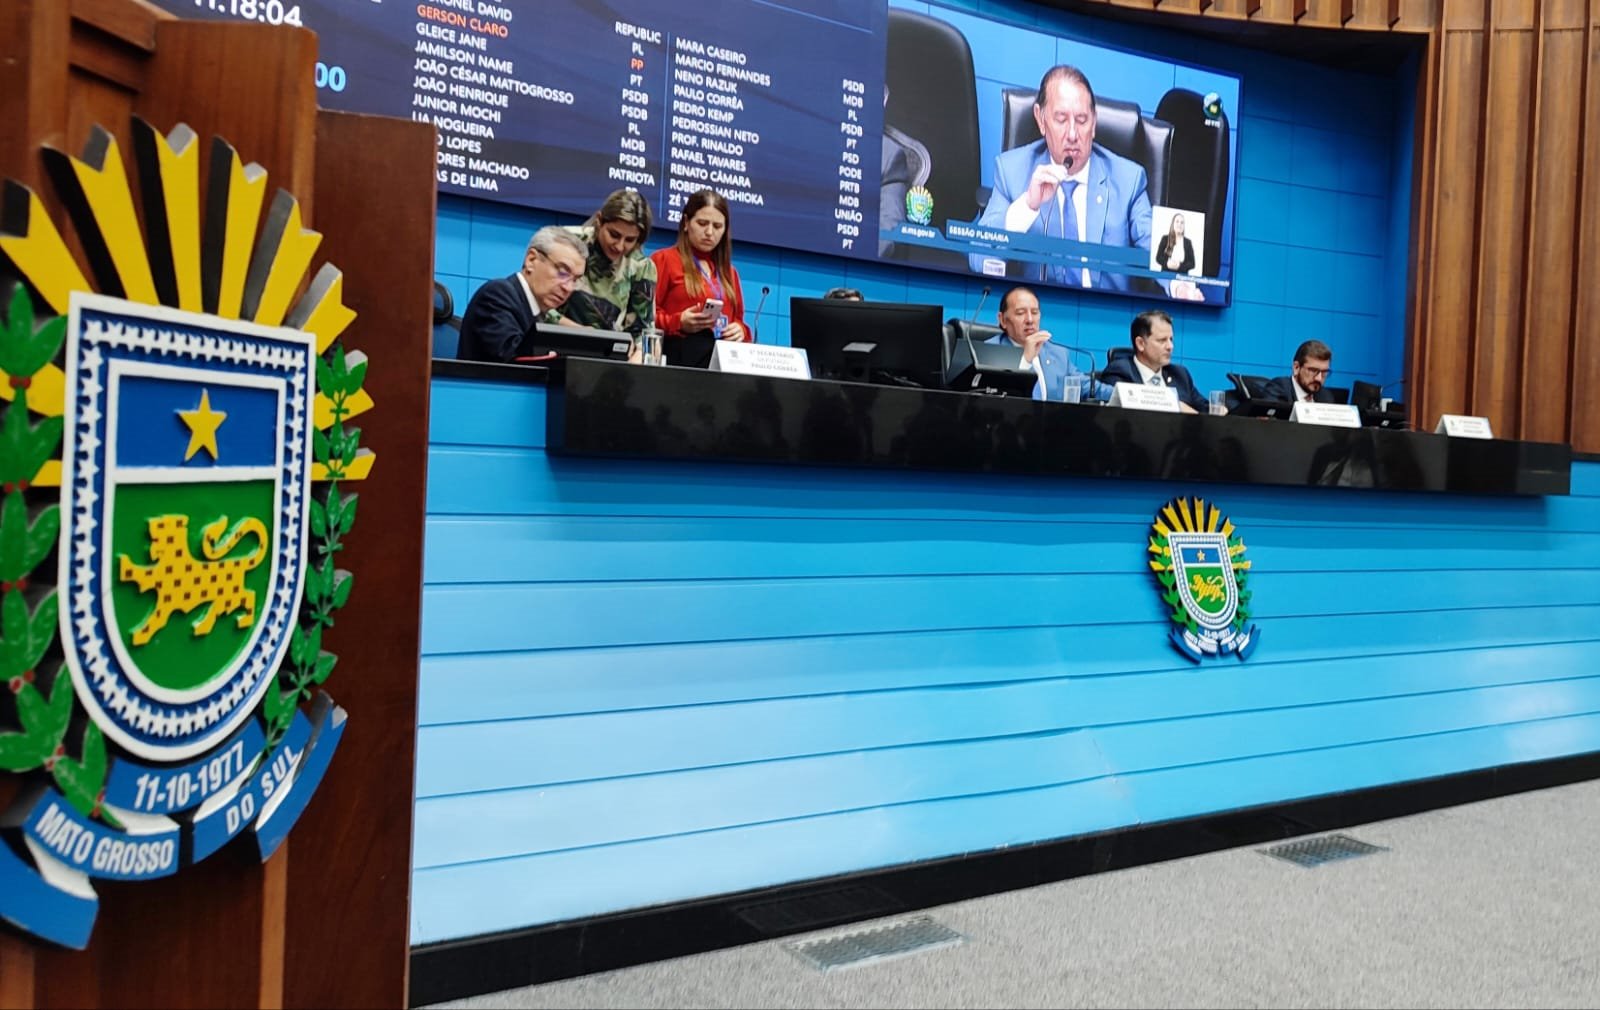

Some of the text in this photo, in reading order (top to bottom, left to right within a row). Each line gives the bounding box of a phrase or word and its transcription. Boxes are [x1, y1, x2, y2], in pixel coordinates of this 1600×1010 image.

[416, 4, 509, 38] GERSON CLARO
[477, 2, 513, 22] DAVID
[415, 22, 487, 51] GLEICE JANE
[615, 21, 662, 44] REPUBLIC
[414, 39, 514, 75] JAMILSON NAME
[632, 42, 645, 57] PL
[676, 37, 747, 65] MARA CASEIRO
[631, 58, 644, 71] PP
[675, 53, 771, 87] MARCIO FERNANDES
[413, 57, 575, 105] JOÃO CÉSAR MATTOGROSSO
[630, 74, 643, 88] PT
[674, 69, 738, 94] NENO RAZUK
[843, 79, 865, 95] PSDB
[412, 75, 509, 108] JOÃO HENRIQUE
[623, 89, 649, 105] PSDB
[673, 84, 705, 102] PAULO
[411, 93, 502, 124] JUNIOR MOCHI
[844, 94, 864, 109] MDB
[622, 105, 648, 121] PSDB
[673, 100, 735, 124] PEDRO KEMP
[848, 110, 858, 122] PL
[433, 115, 495, 140] NOGUEIRA
[629, 123, 641, 136] PL
[672, 115, 760, 145] PEDROSSIAN NETO
[841, 122, 863, 137] PSDB
[446, 135, 482, 154] LOPES
[621, 138, 646, 153] MDB
[671, 131, 744, 157] PROF. RINALDO
[847, 138, 857, 150] PT
[620, 153, 646, 169] PSDB
[671, 147, 747, 173] RAFAEL TAVARES
[843, 152, 860, 165] PSD
[468, 158, 530, 181] MACHADO
[608, 166, 656, 187] PATRIOTA
[670, 162, 752, 189] RENATO CÂMARA
[839, 165, 863, 180] PODE
[450, 171, 467, 187] DE
[469, 175, 499, 193] LIMA
[840, 180, 860, 195] PRTB
[669, 194, 681, 207] ZÉ
[839, 194, 860, 208] MDB
[835, 208, 863, 224] UNIÃO
[838, 223, 859, 237] PSDB
[949, 225, 975, 239] SESSÃO
[843, 238, 854, 250] PT
[134, 741, 244, 811] 11-10-1977
[225, 745, 300, 836] DO SUL
[34, 802, 175, 875] MATO GROSSO
